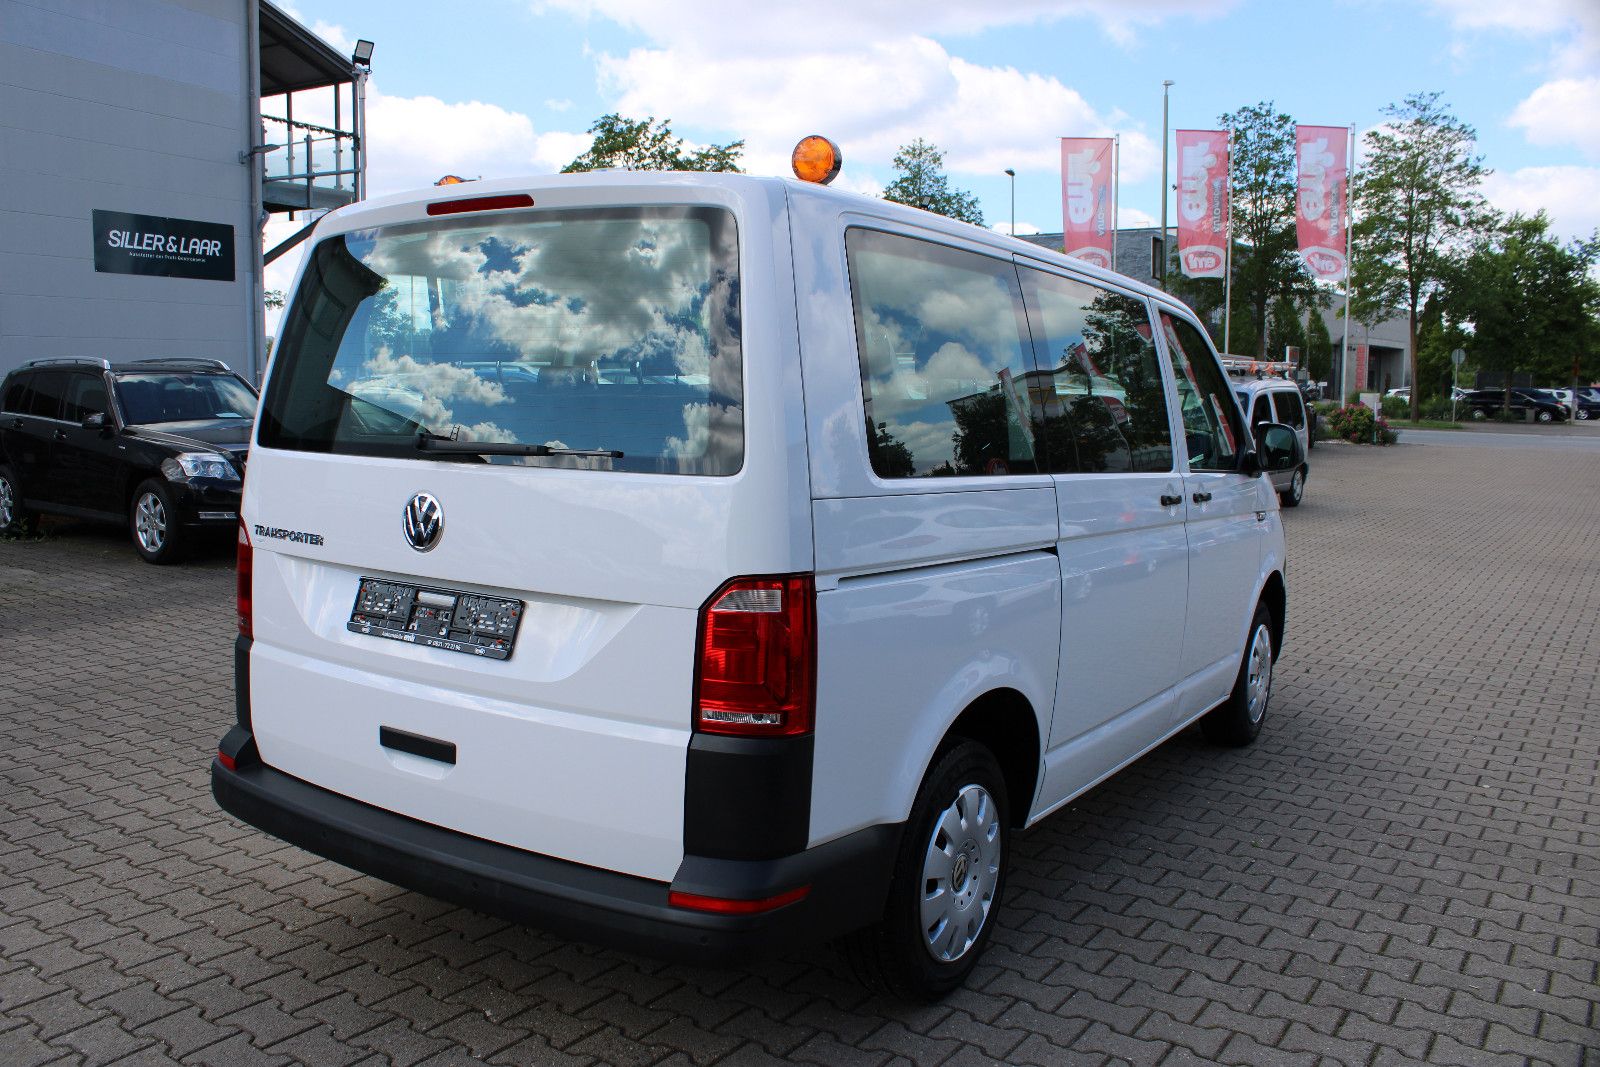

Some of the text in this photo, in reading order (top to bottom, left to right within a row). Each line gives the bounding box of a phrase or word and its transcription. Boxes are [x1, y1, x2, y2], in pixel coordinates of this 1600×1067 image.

[107, 229, 221, 257] SILLER & LAAR
[254, 524, 324, 546] TRANSPORTER
